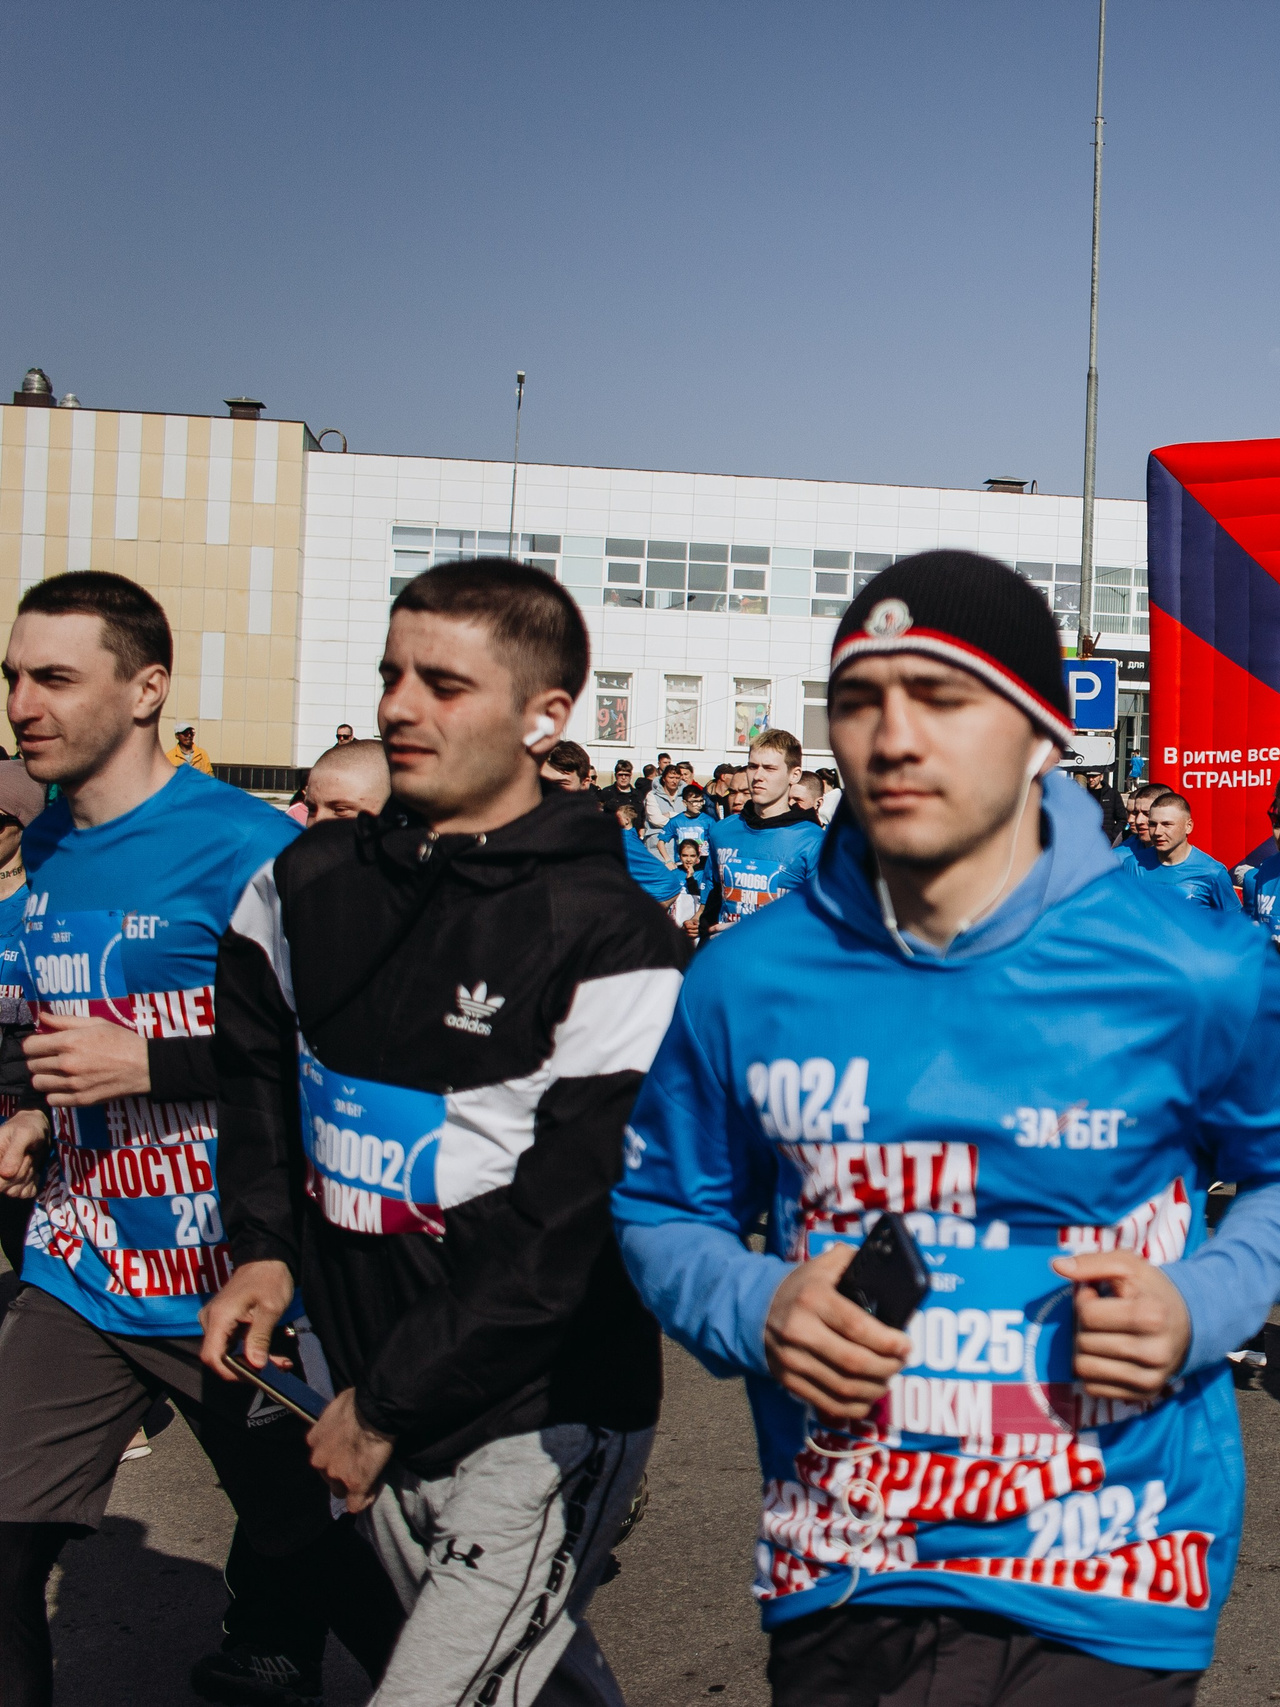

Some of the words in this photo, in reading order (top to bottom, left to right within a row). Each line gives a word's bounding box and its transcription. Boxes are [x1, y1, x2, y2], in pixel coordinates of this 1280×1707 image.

[1068, 671, 1102, 720] P
[597, 708, 610, 728] 9
[1163, 747, 1178, 765] В
[1182, 749, 1242, 767] ритме
[1182, 768, 1272, 789] СТРАНЫ!
[734, 872, 768, 891] 20066
[34, 953, 91, 995] 30011
[443, 1012, 492, 1036] adidas
[747, 1056, 870, 1143] 2024
[313, 1115, 406, 1193] 30002
[322, 1178, 383, 1235] 10КМ
[890, 1379, 993, 1437] 10КМ
